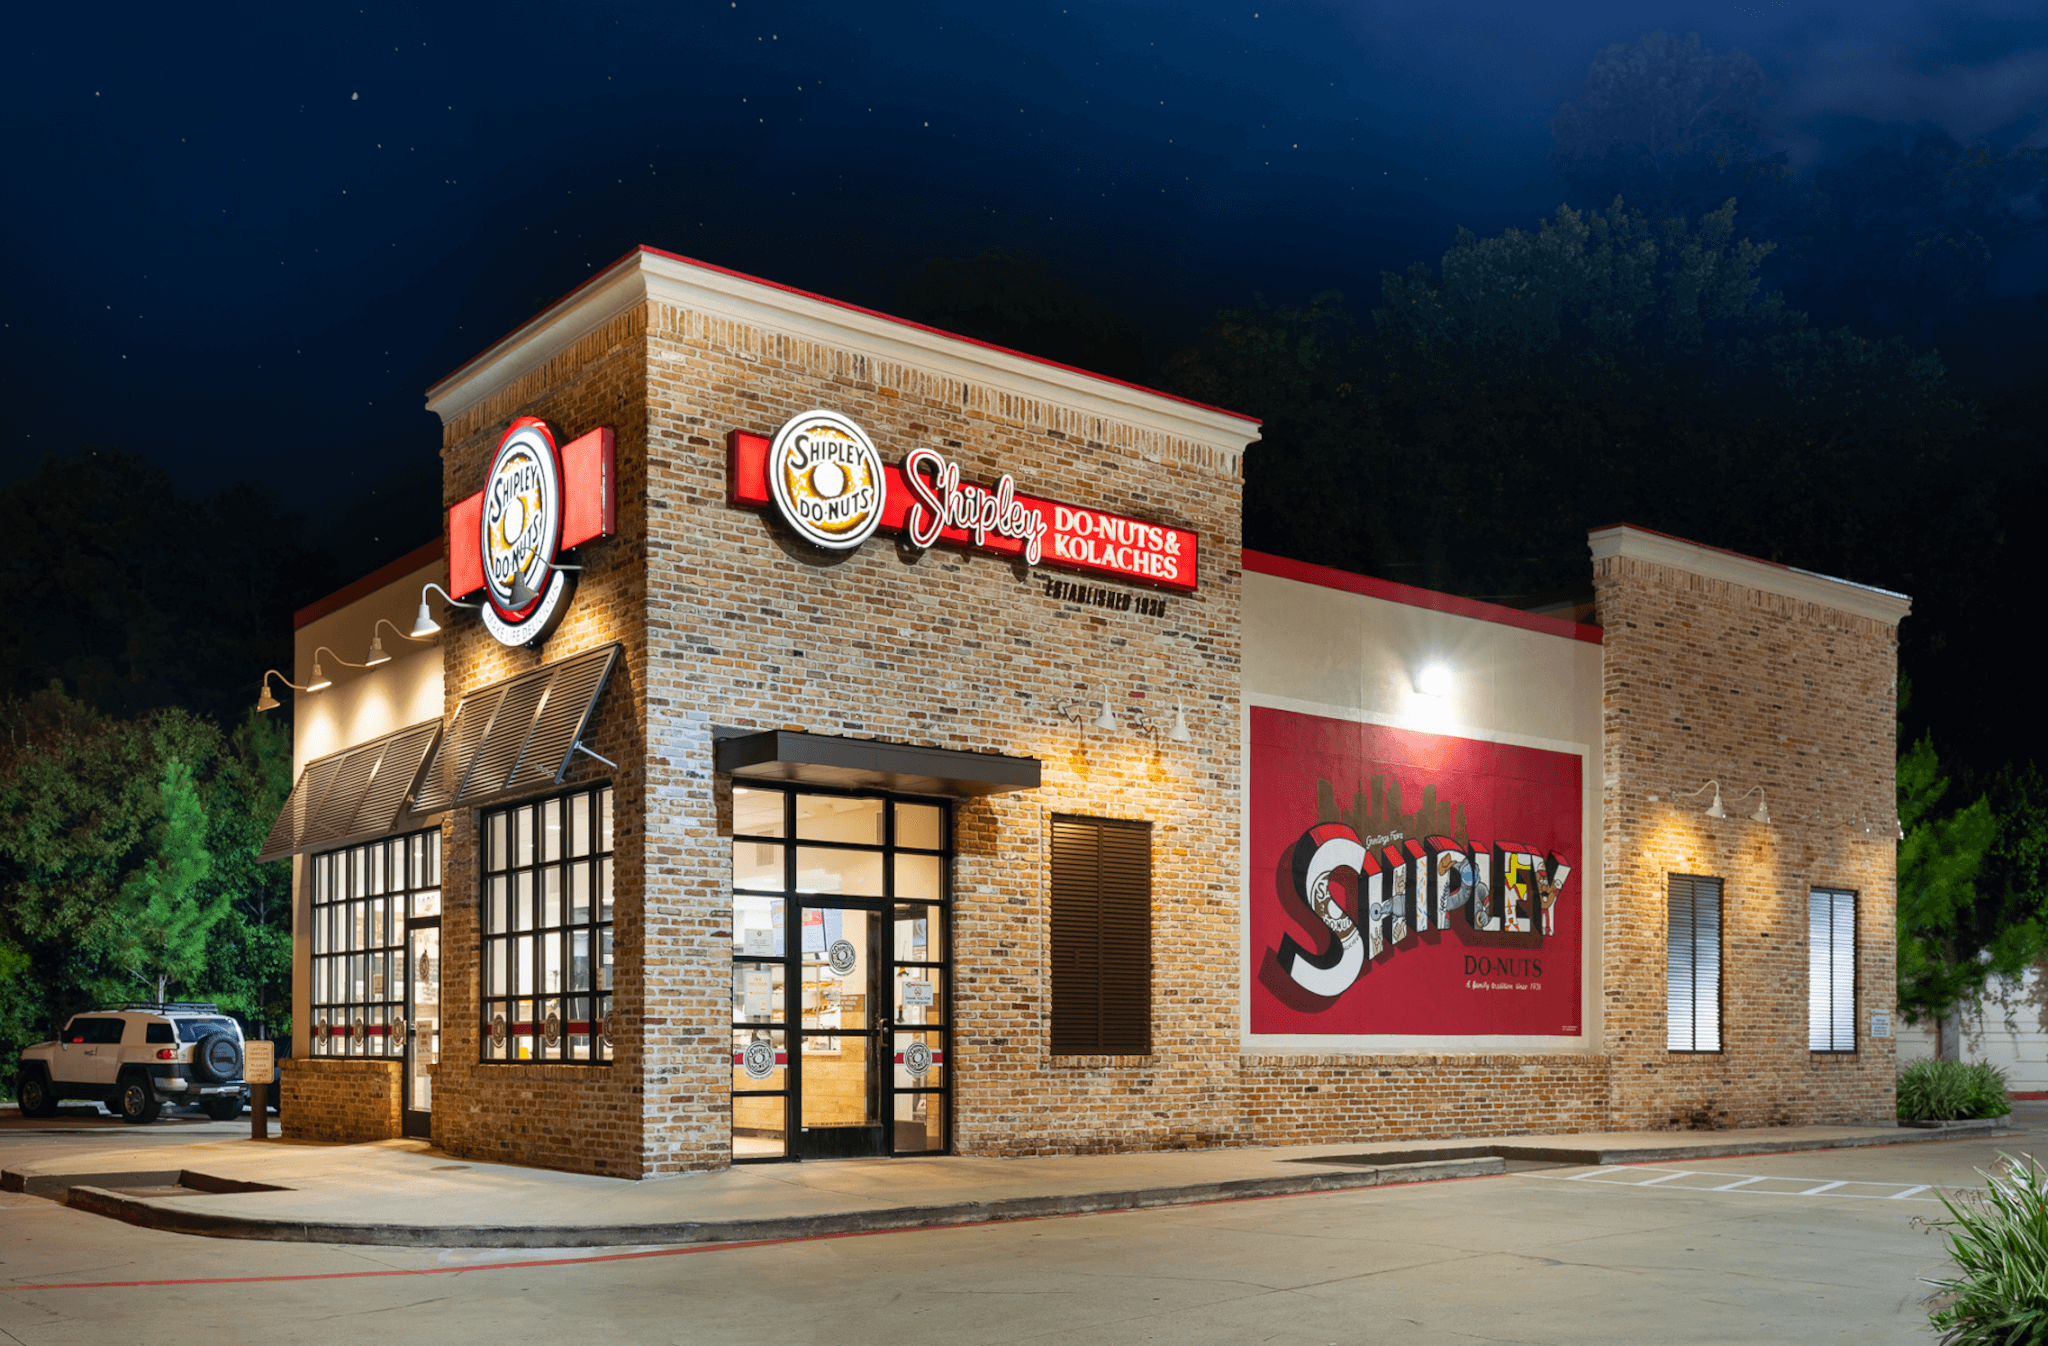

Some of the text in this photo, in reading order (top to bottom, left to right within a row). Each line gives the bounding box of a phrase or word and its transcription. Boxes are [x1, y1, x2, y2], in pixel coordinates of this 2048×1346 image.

[790, 434, 865, 470] SHIPLEY
[491, 465, 538, 523] SHIPLEY
[905, 447, 1047, 566] Shipley
[1054, 533, 1178, 580] KOLACHES
[1045, 579, 1131, 611] ESTABLISHED
[1278, 821, 1571, 997] SHIPLEY
